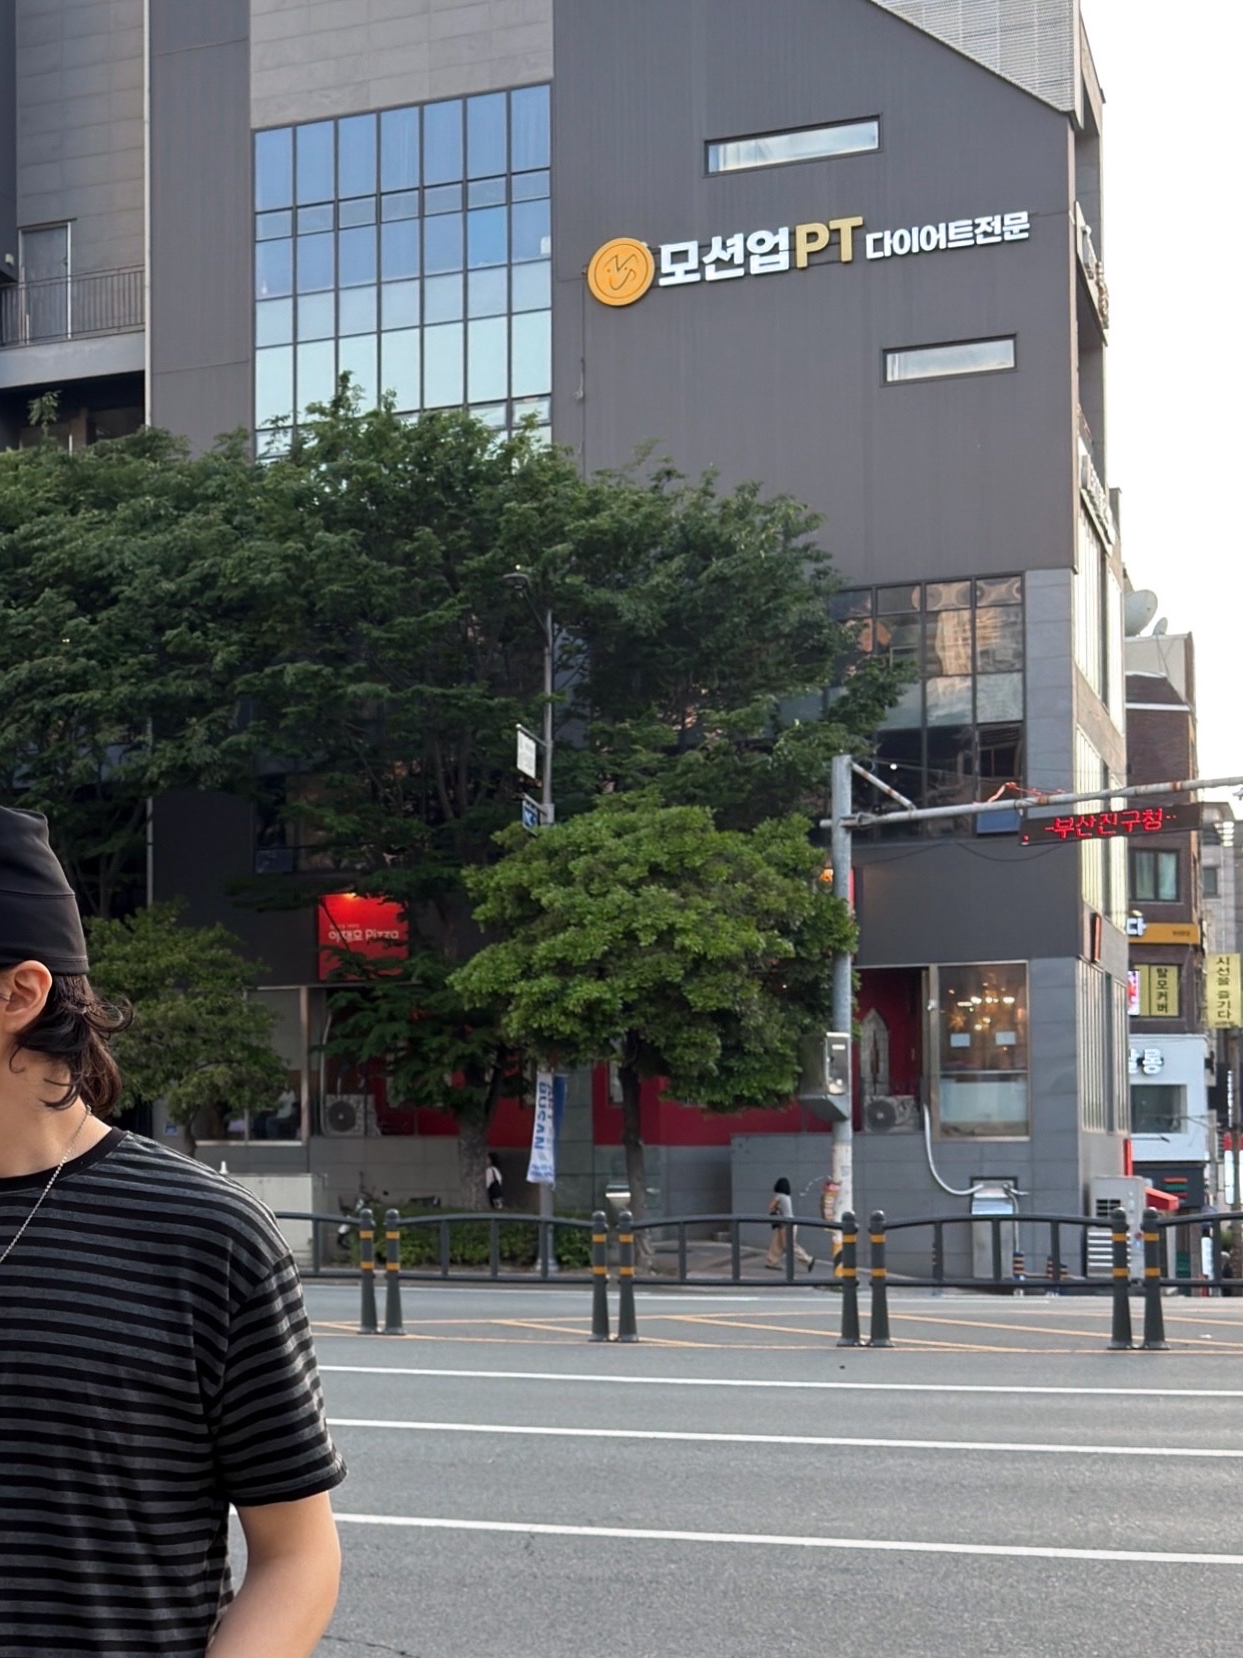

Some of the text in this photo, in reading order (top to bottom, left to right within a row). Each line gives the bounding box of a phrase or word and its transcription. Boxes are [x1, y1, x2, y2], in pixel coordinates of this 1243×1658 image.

[866, 210, 1031, 260] 다이어트전문
[1055, 808, 1163, 840] 부산진구청
[365, 929, 399, 941] Pizza
[534, 1082, 548, 1150] BUSAN
